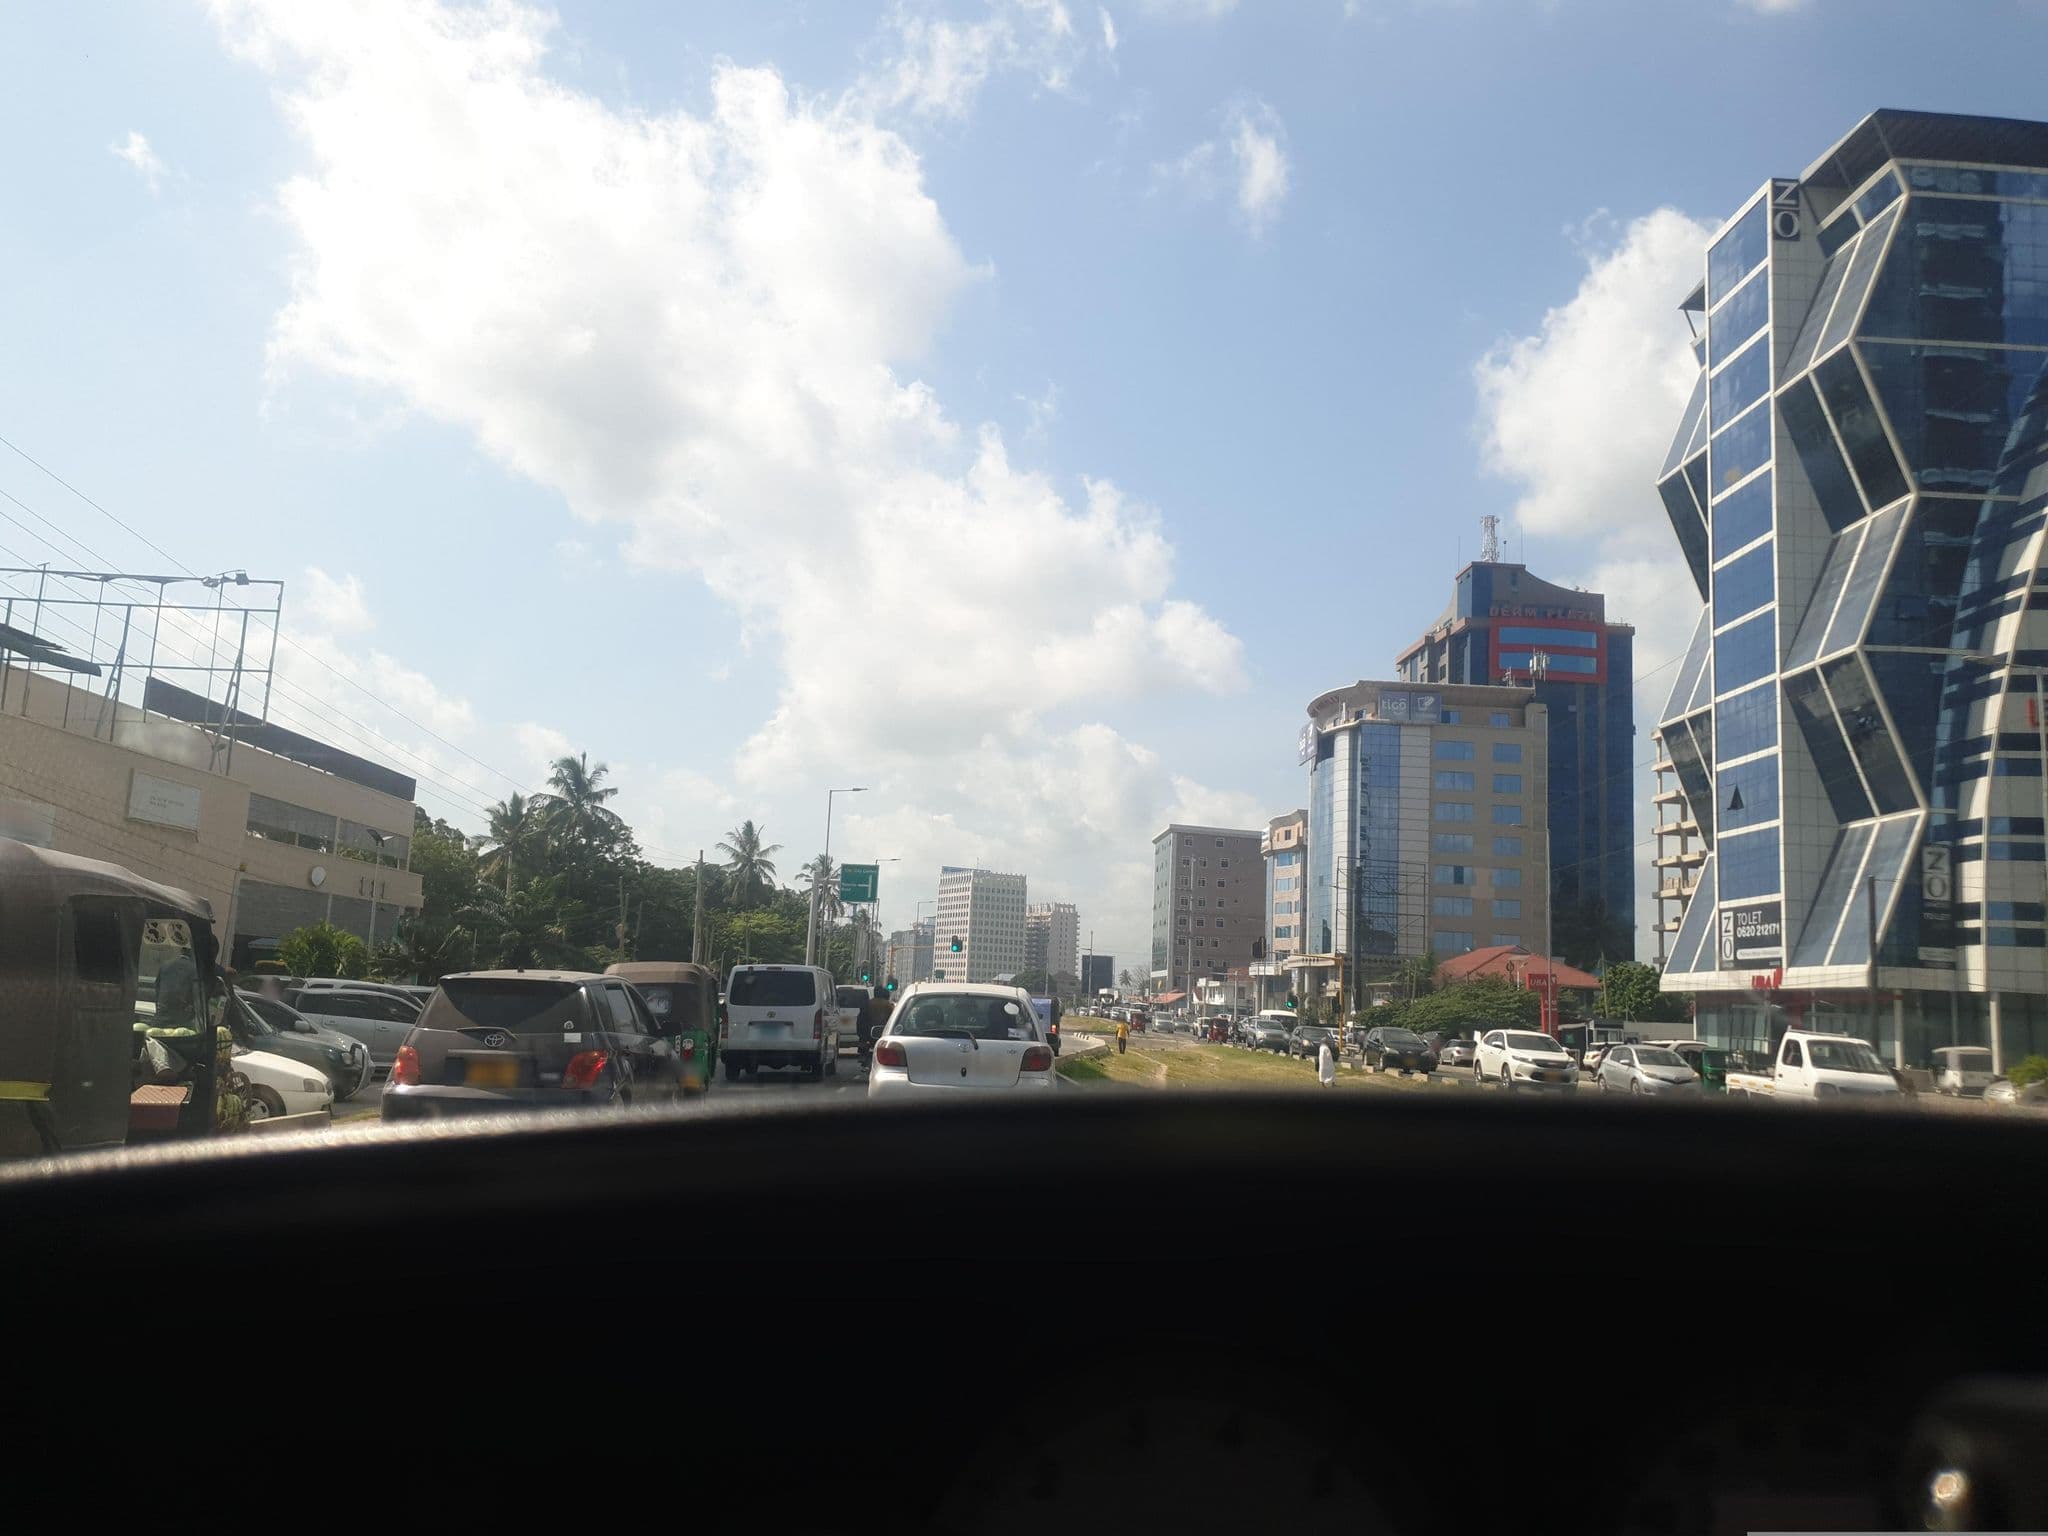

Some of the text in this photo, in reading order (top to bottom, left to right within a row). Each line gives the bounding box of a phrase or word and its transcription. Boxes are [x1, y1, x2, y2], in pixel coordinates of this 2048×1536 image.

[1488, 607, 1537, 617] DERM
[1381, 698, 1407, 715] tigo
[1736, 911, 1763, 926] TO LET
